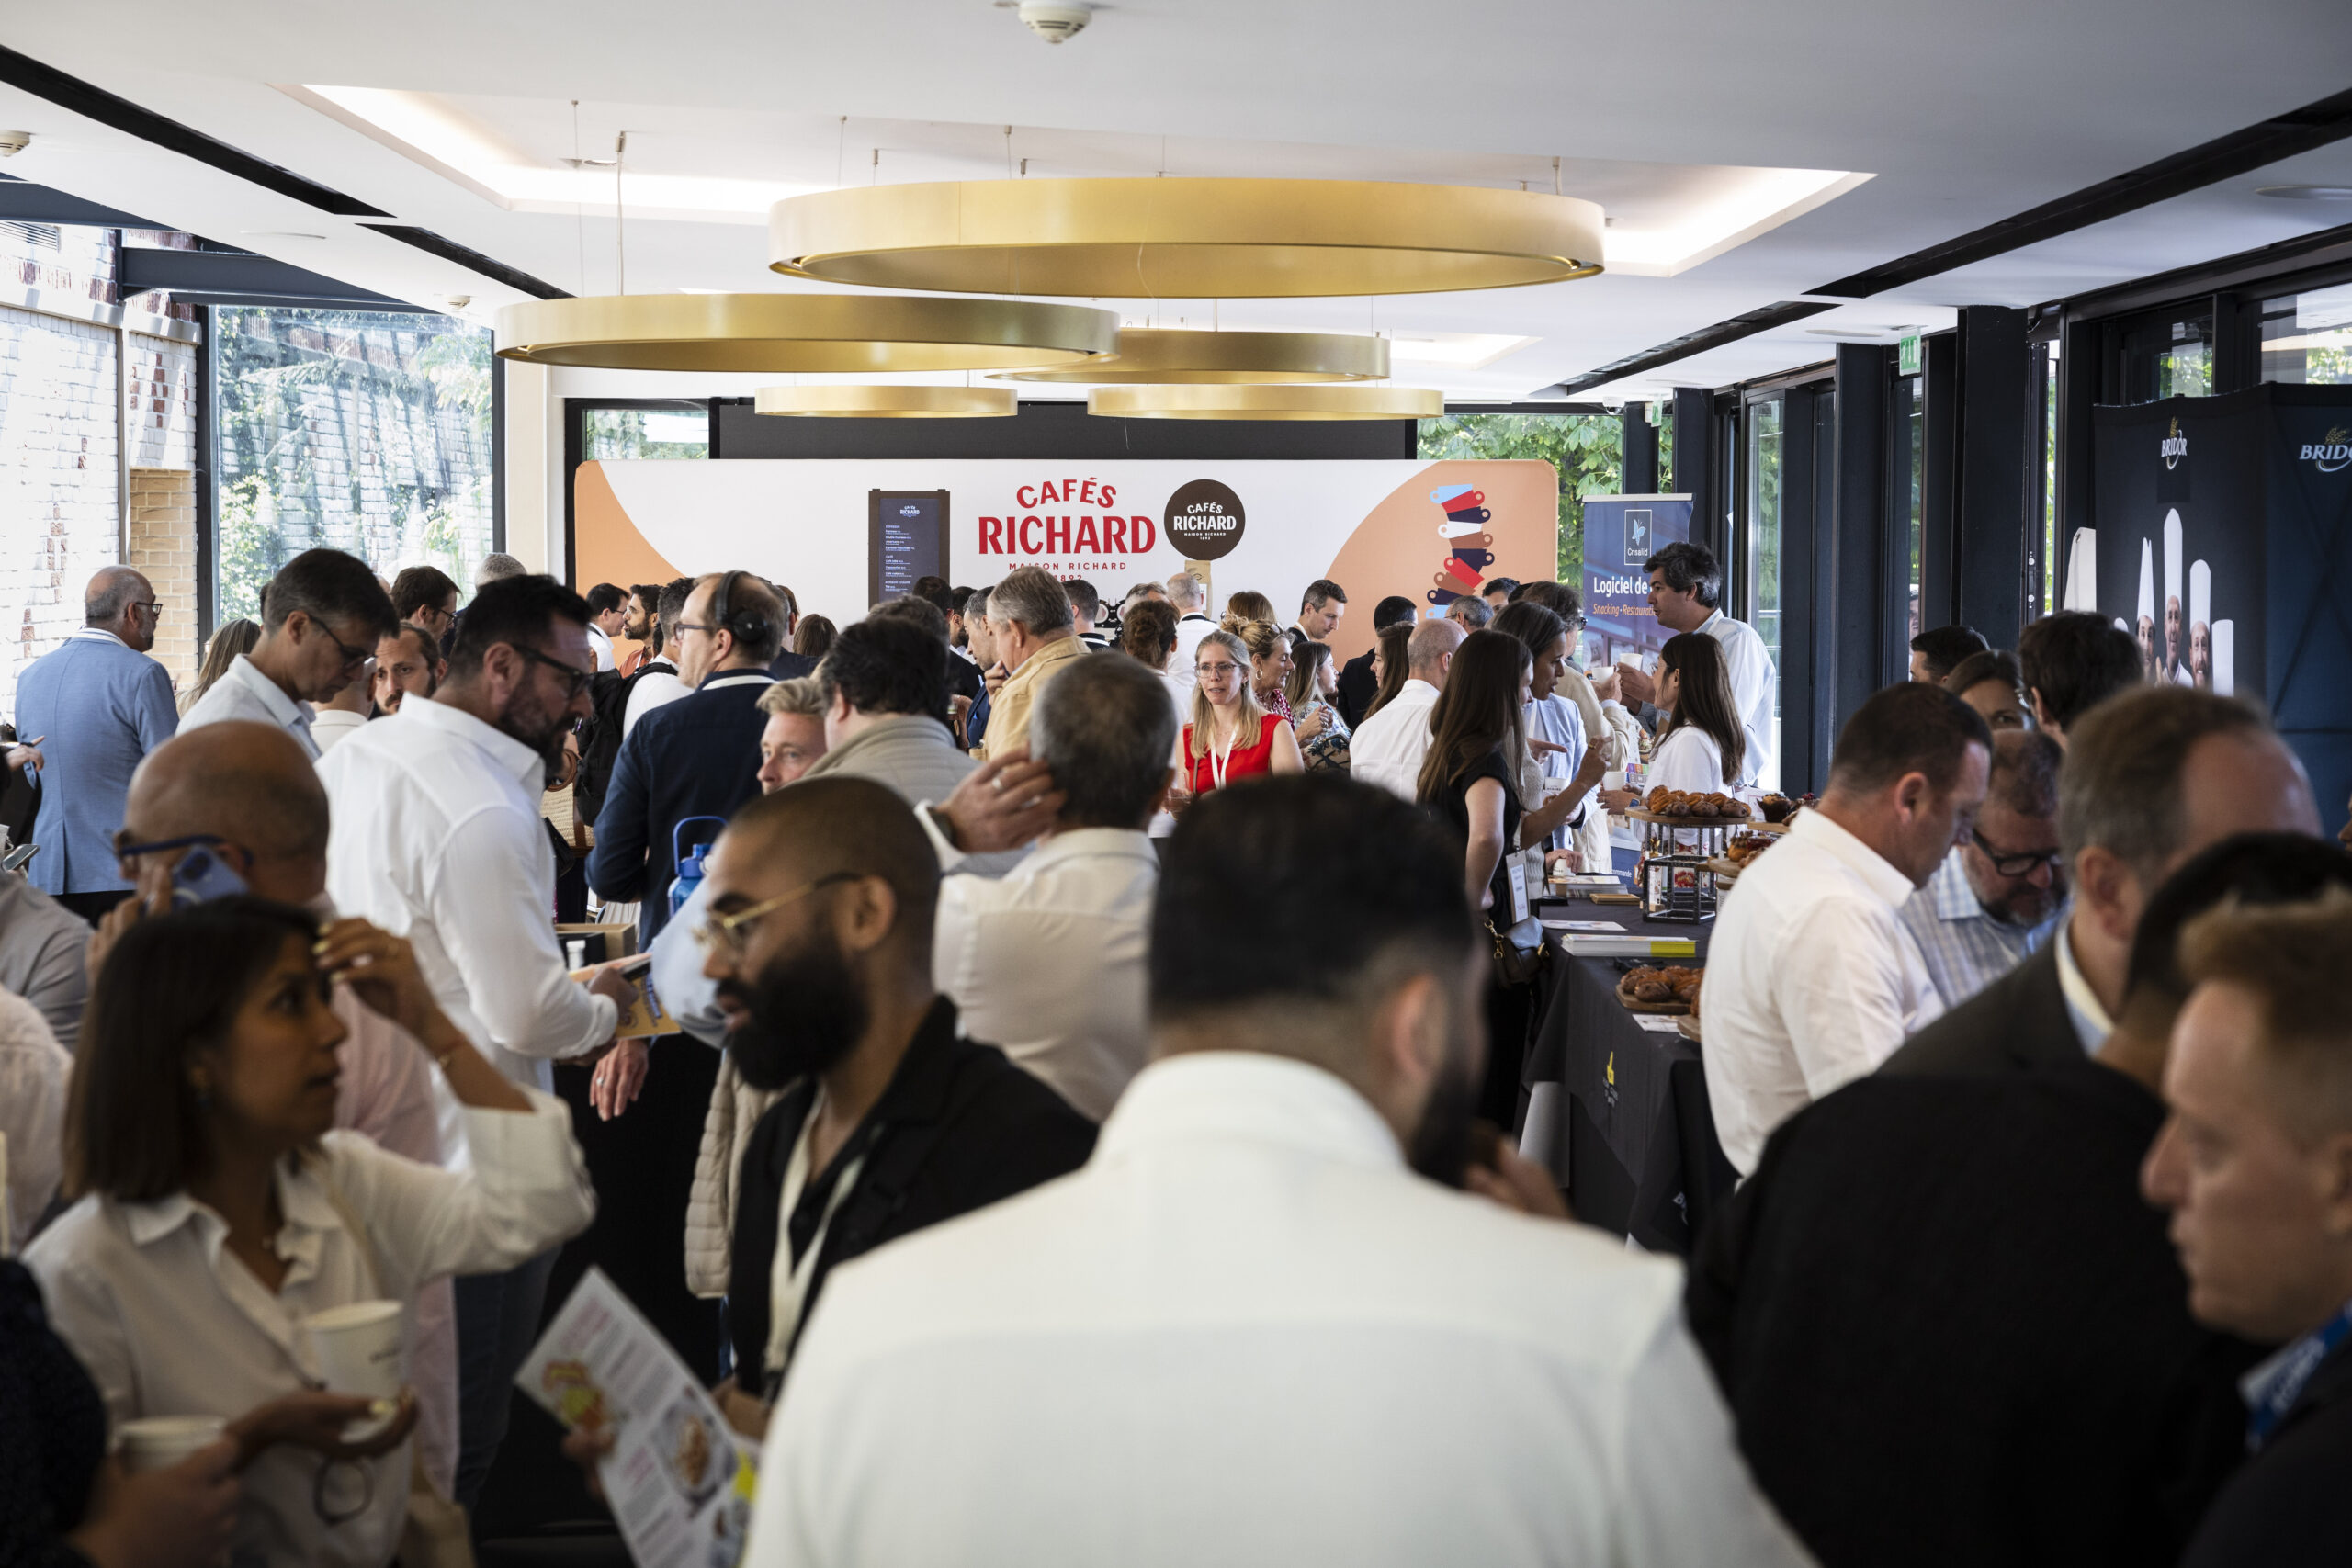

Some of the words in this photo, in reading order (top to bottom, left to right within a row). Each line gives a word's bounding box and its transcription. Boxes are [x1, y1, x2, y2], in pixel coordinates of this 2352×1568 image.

[2161, 437, 2188, 457] BRIDOR
[2300, 445, 2352, 460] BRID
[1016, 477, 1117, 509] CAFÉS
[1186, 502, 1224, 514] CAFÉS
[1173, 515, 1237, 531] RICHARD
[978, 515, 1157, 555] RICHARD
[1627, 547, 1648, 557] Crisalid
[1593, 576, 1633, 597] Logiciel
[1634, 576, 1647, 594] de
[1593, 604, 1619, 616] Snacking
